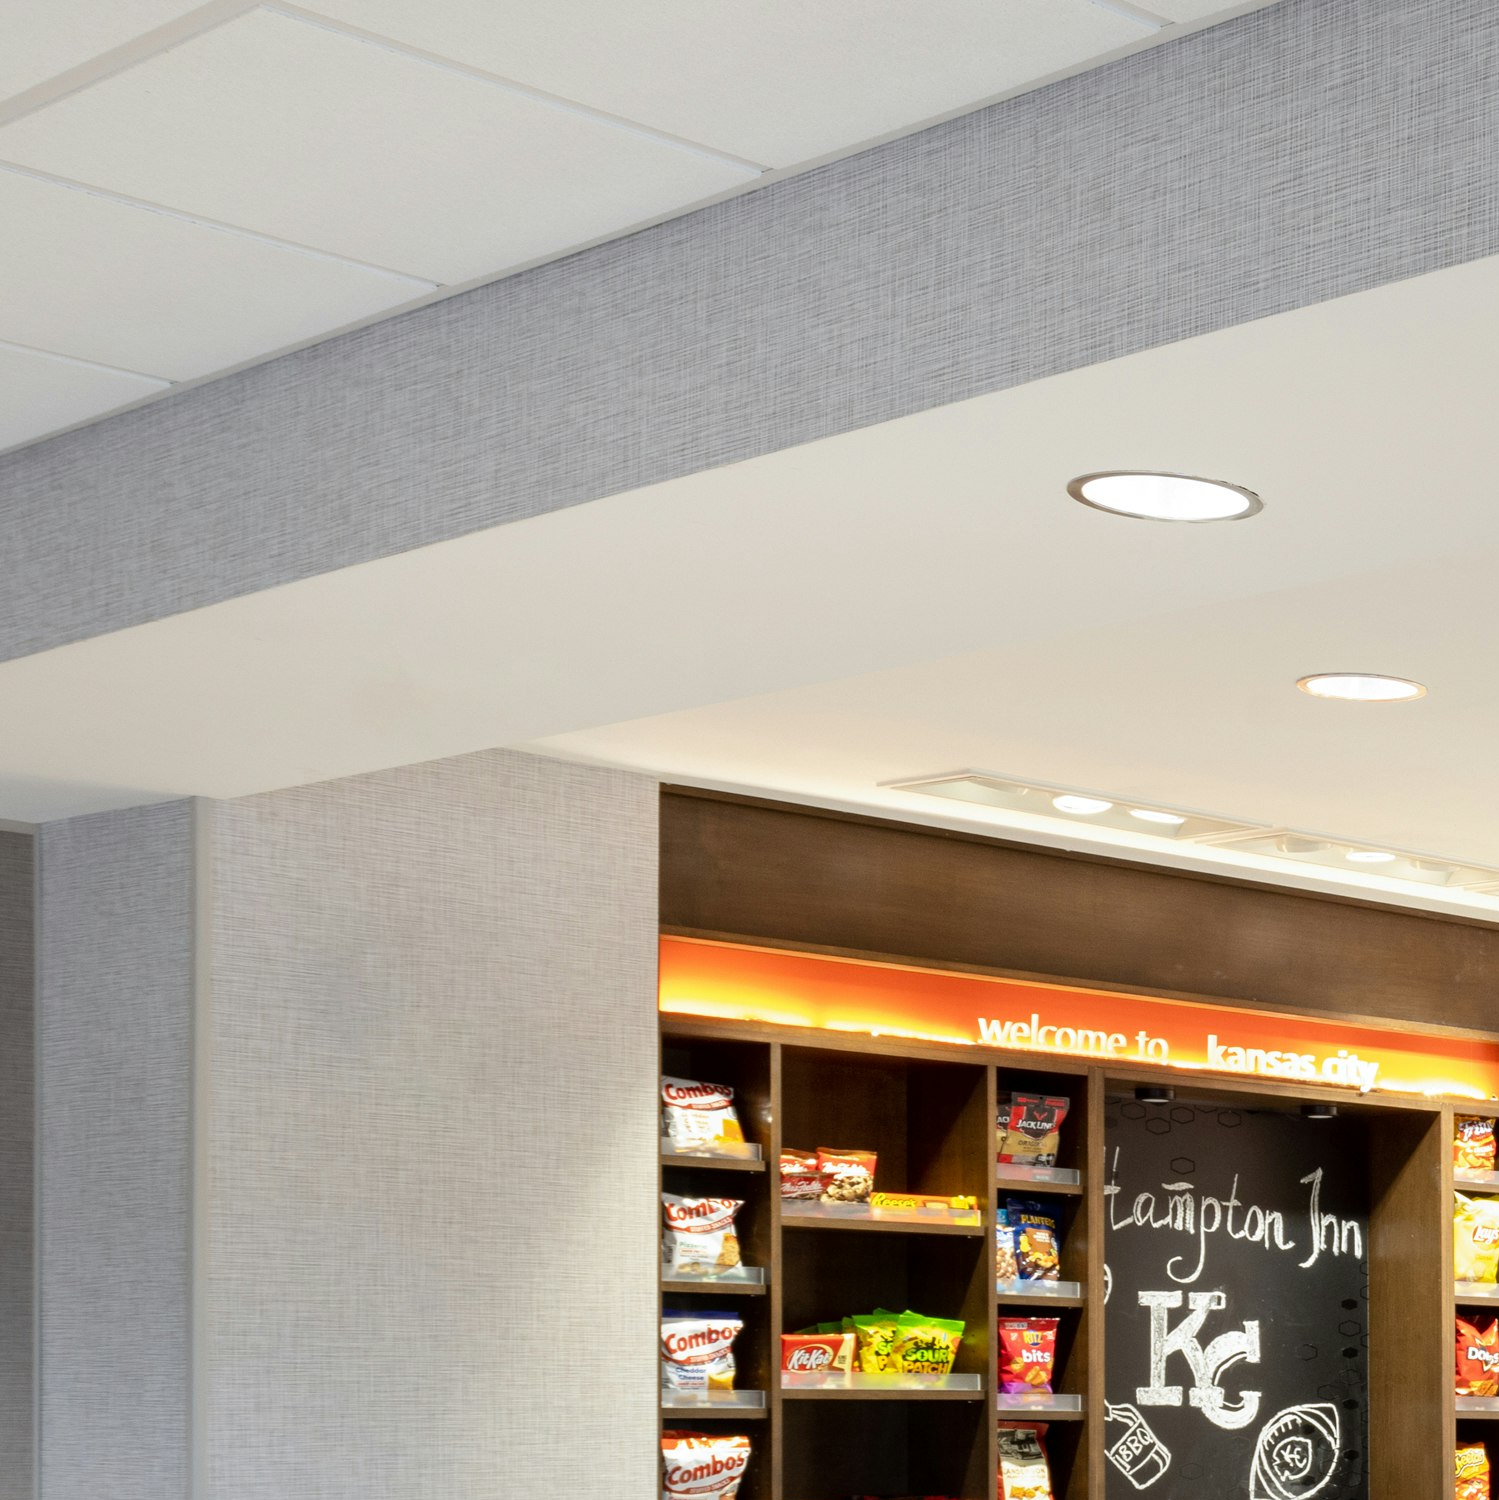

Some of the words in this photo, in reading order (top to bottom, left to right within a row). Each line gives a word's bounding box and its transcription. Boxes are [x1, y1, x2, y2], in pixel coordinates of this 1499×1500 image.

[978, 1014, 1128, 1061] welcome
[1136, 1031, 1169, 1066] to
[1207, 1034, 1316, 1079] kansas
[1322, 1050, 1379, 1094] city
[664, 1083, 732, 1100] Combos
[1016, 1119, 1037, 1130] JACK
[1298, 1167, 1363, 1268] Inn
[664, 1326, 741, 1355] Combos
[902, 1361, 948, 1374] PATCH
[906, 1348, 948, 1363] SOUR
[1021, 1349, 1051, 1363] bits
[1136, 1290, 1262, 1429] KC
[1117, 1426, 1154, 1464] BBQ
[667, 1454, 745, 1486] Combos
